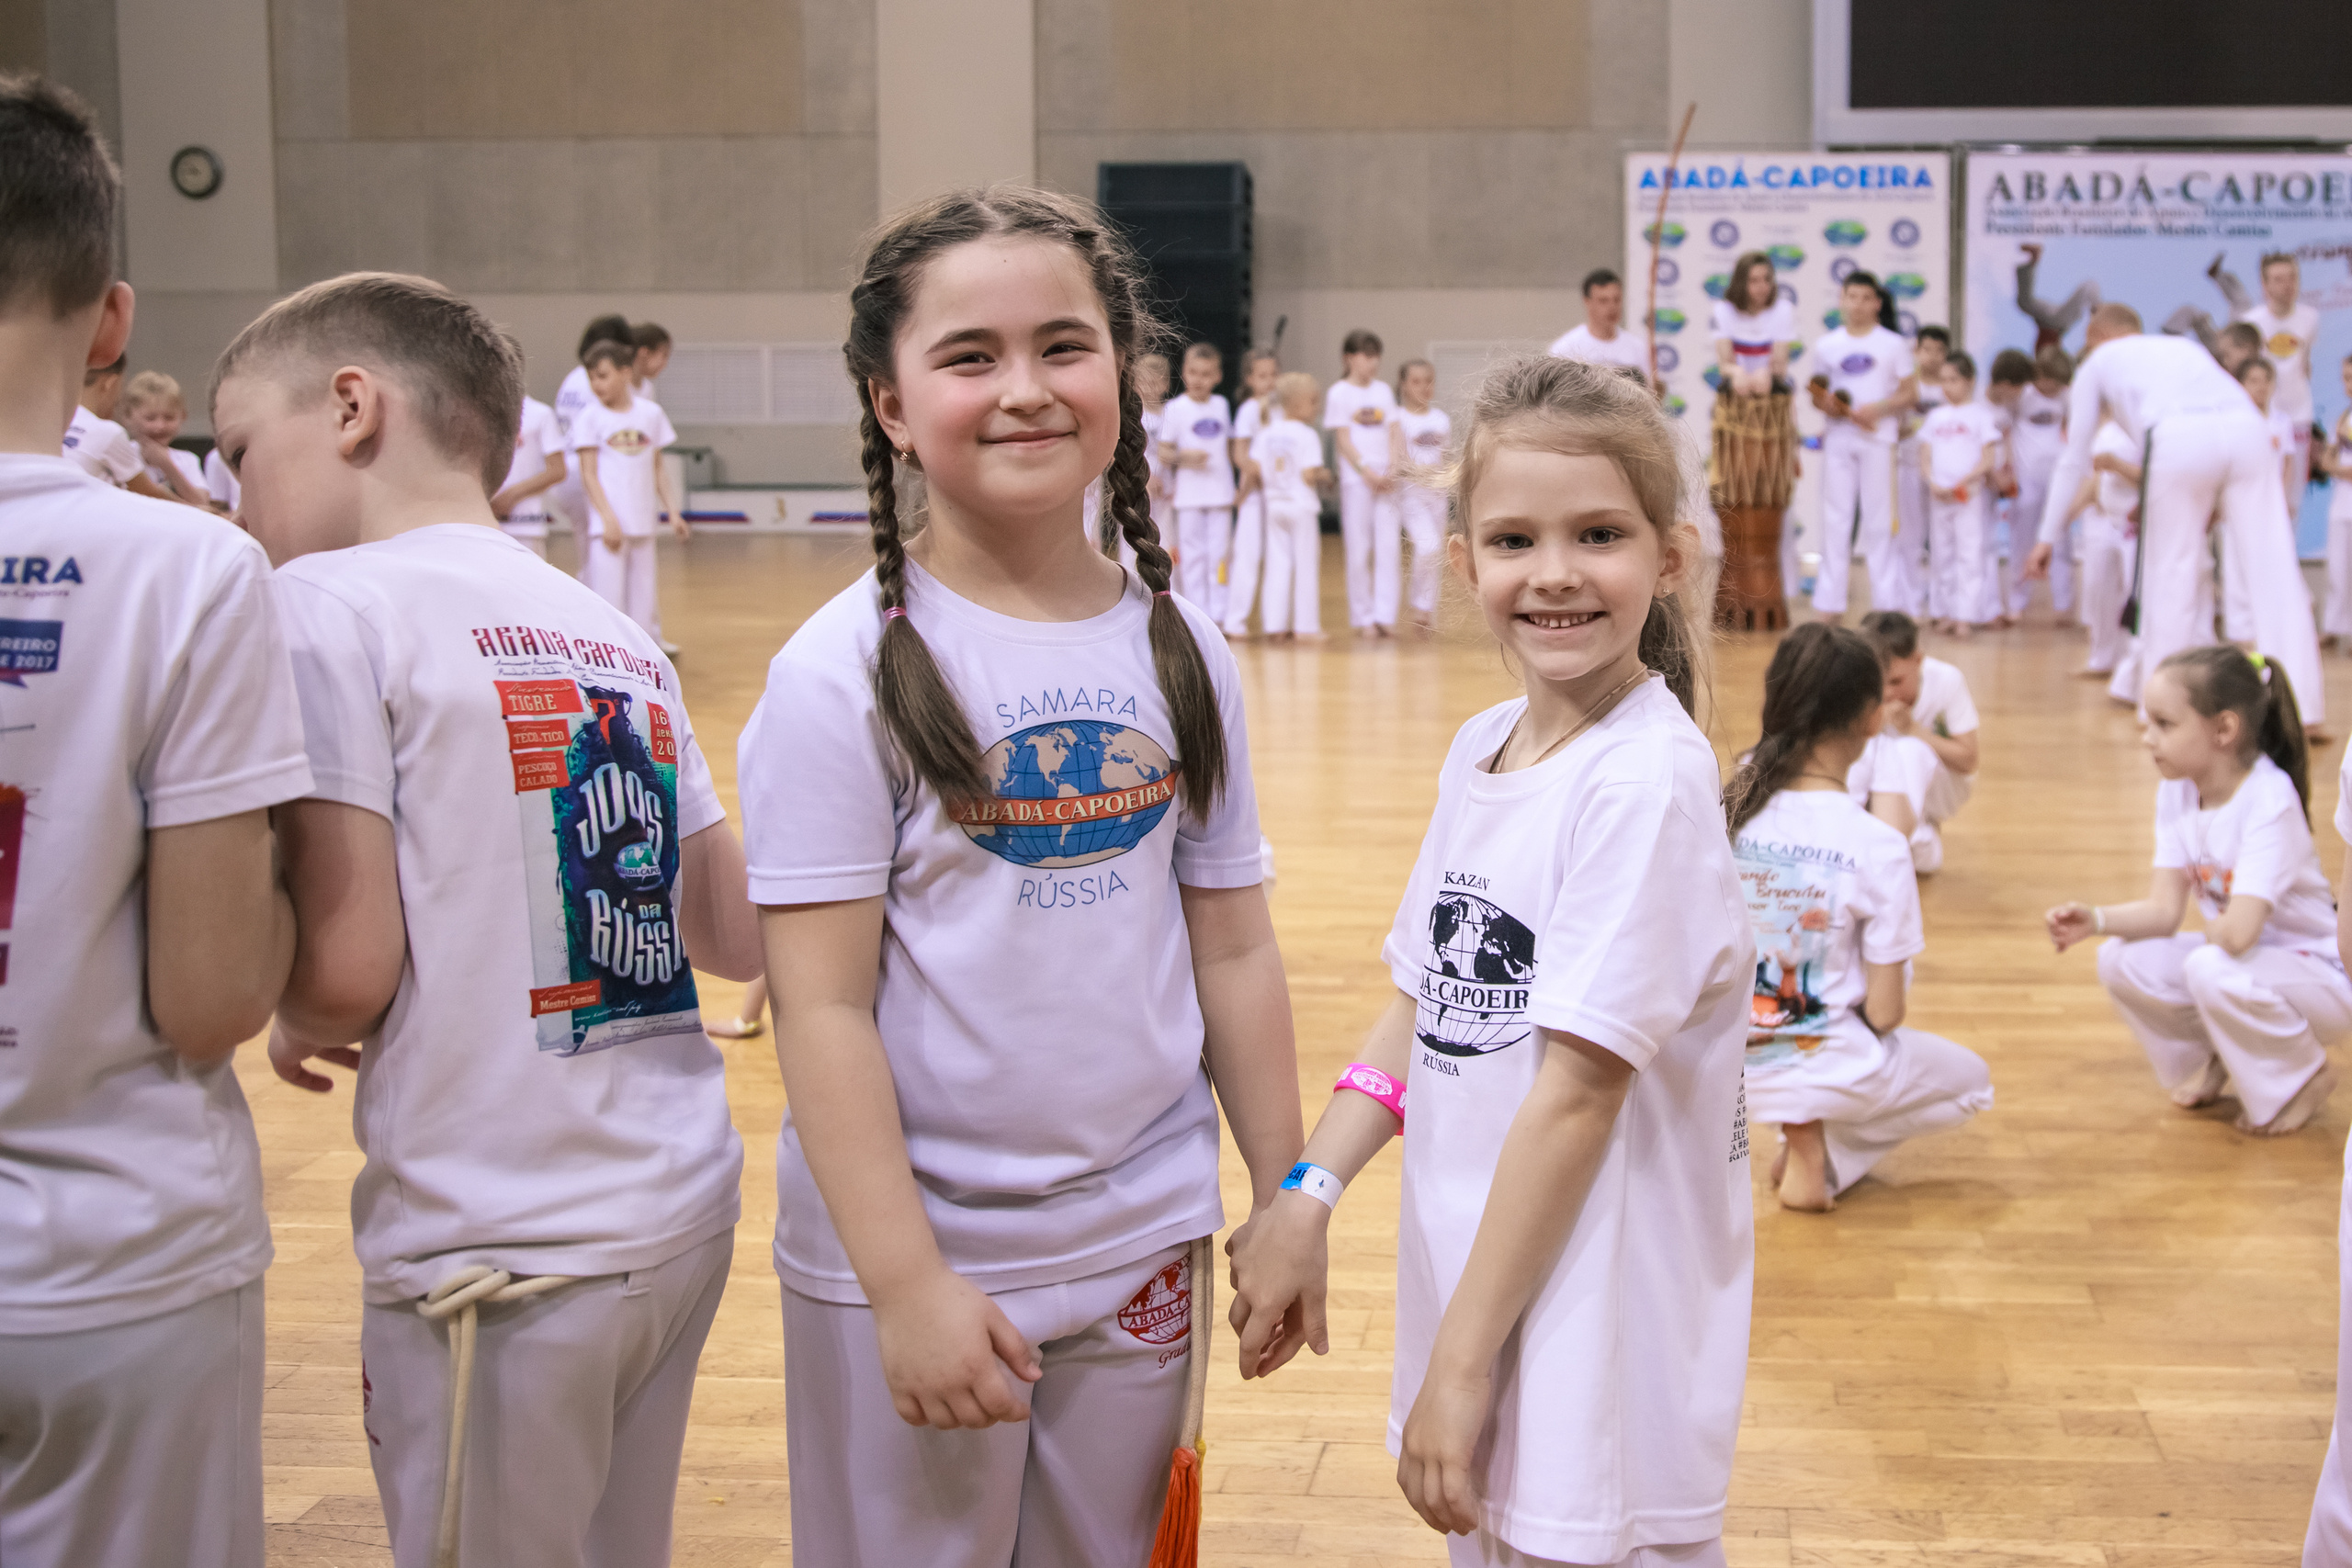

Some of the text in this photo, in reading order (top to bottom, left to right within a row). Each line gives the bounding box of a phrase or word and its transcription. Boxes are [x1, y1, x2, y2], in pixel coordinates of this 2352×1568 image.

[1639, 158, 1934, 189] ABADÁ-CAPOEIRA
[16, 654, 55, 669] 2017
[508, 694, 558, 712] TIGRE
[996, 686, 1137, 728] SAMARA
[519, 774, 559, 788] CALADO
[960, 780, 1172, 822] ABADÁ-CAPOEIRA
[1017, 870, 1129, 909] RÚSSIA
[1443, 871, 1490, 891] KAZAN
[585, 888, 687, 987] RÚSSI
[540, 998, 569, 1010] Mestre
[1422, 1052, 1461, 1077] RÚSSIA
